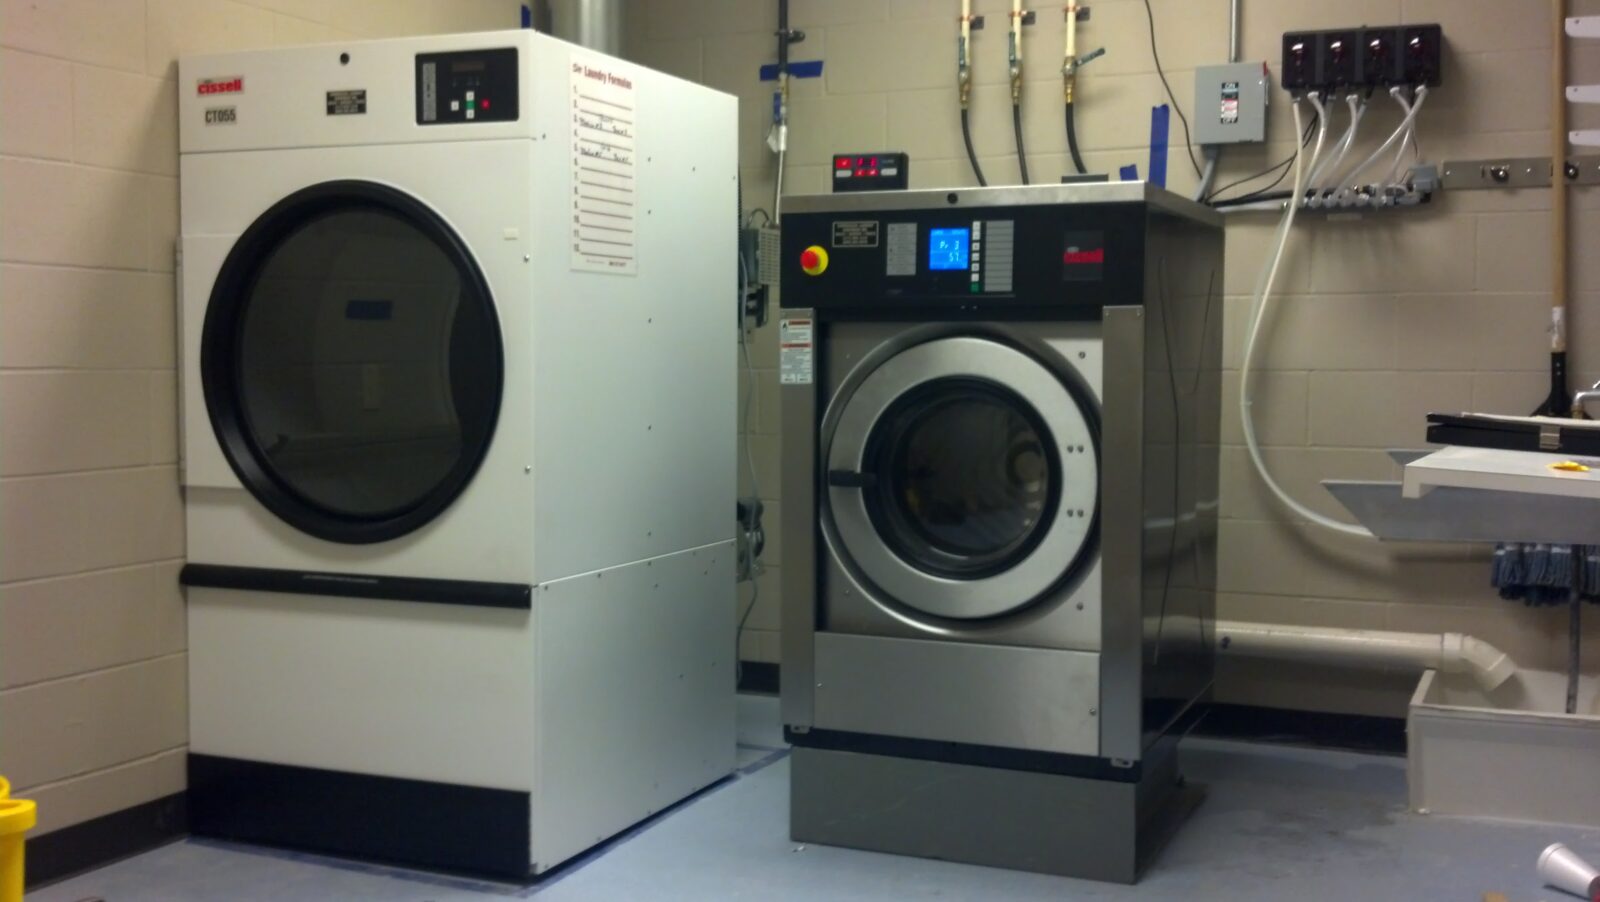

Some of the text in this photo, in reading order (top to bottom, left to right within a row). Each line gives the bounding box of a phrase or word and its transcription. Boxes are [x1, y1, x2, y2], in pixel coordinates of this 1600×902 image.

[584, 66, 606, 84] Laundry
[608, 73, 632, 90] Formulas
[197, 79, 242, 95] cissell
[205, 108, 236, 123] CT055
